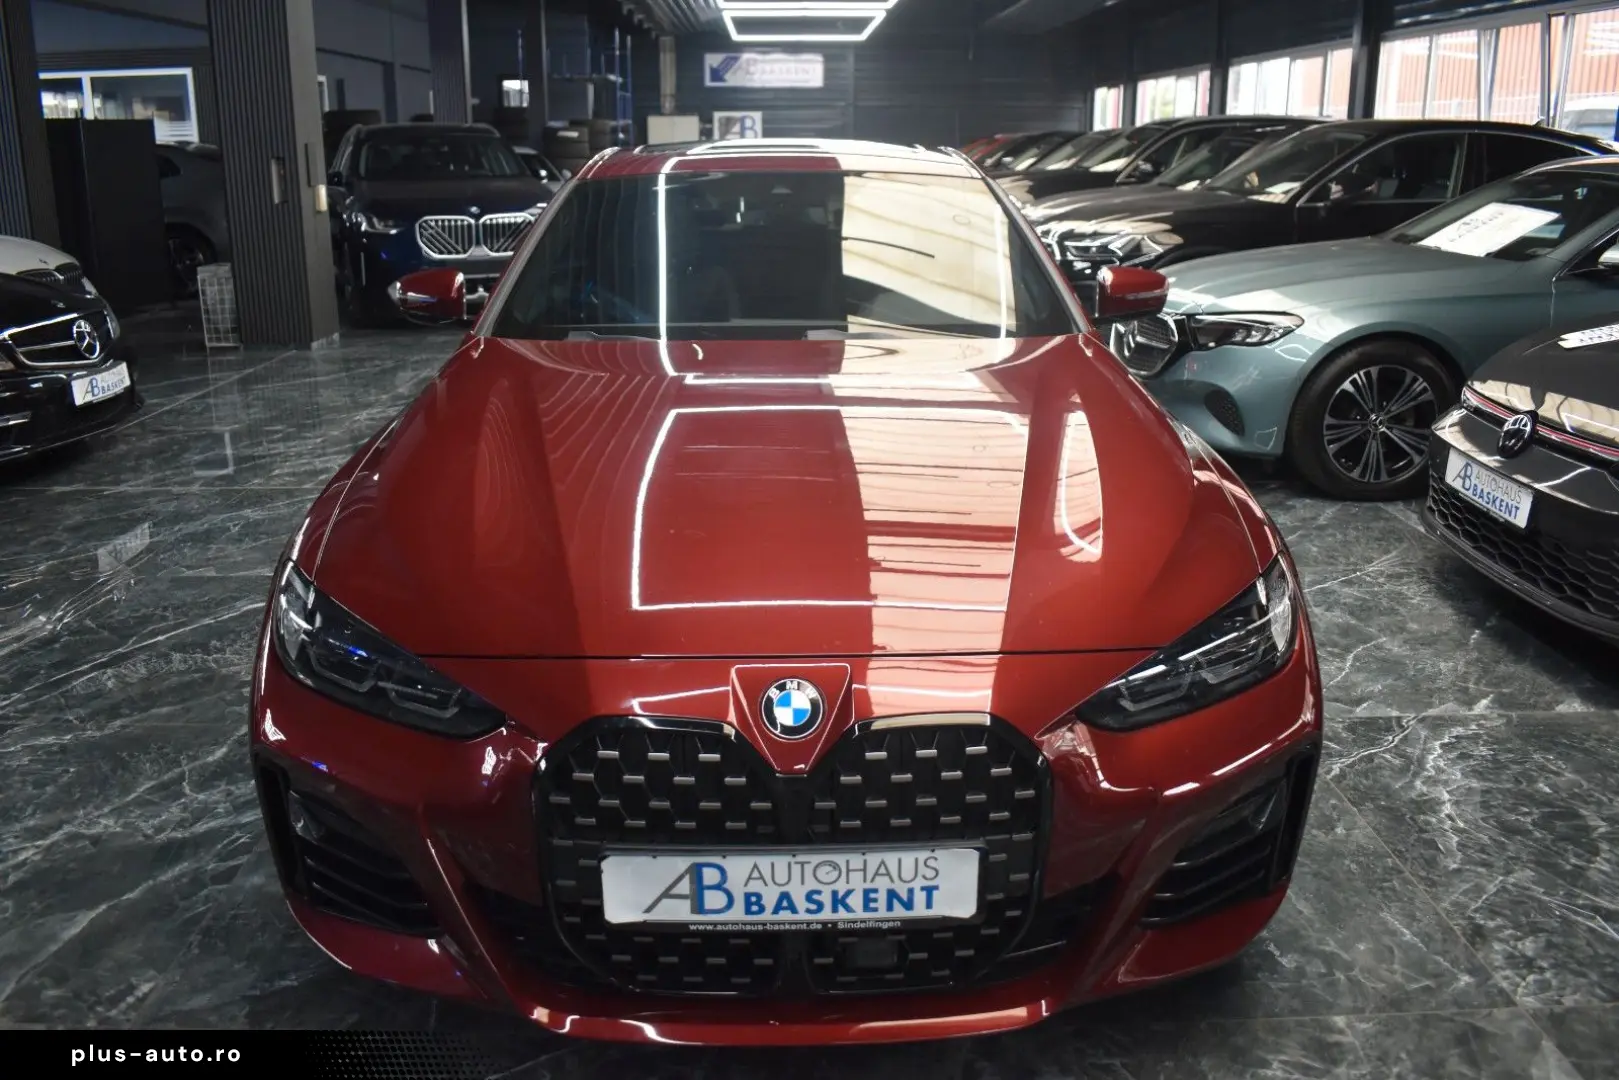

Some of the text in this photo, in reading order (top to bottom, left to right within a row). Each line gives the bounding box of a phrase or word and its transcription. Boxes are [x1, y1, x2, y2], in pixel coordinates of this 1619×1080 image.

[82, 377, 101, 401] AB
[1452, 461, 1473, 492] AB
[1475, 468, 1522, 505] AUTOHAUS
[1471, 483, 1521, 520] BASKENT
[768, 680, 817, 700] BMW
[743, 855, 940, 888] AUTOHAUS
[642, 862, 735, 915] AB
[743, 884, 940, 916] BASKENT
[688, 920, 901, 931] www.autohaus-baskent.de Sindelfingen
